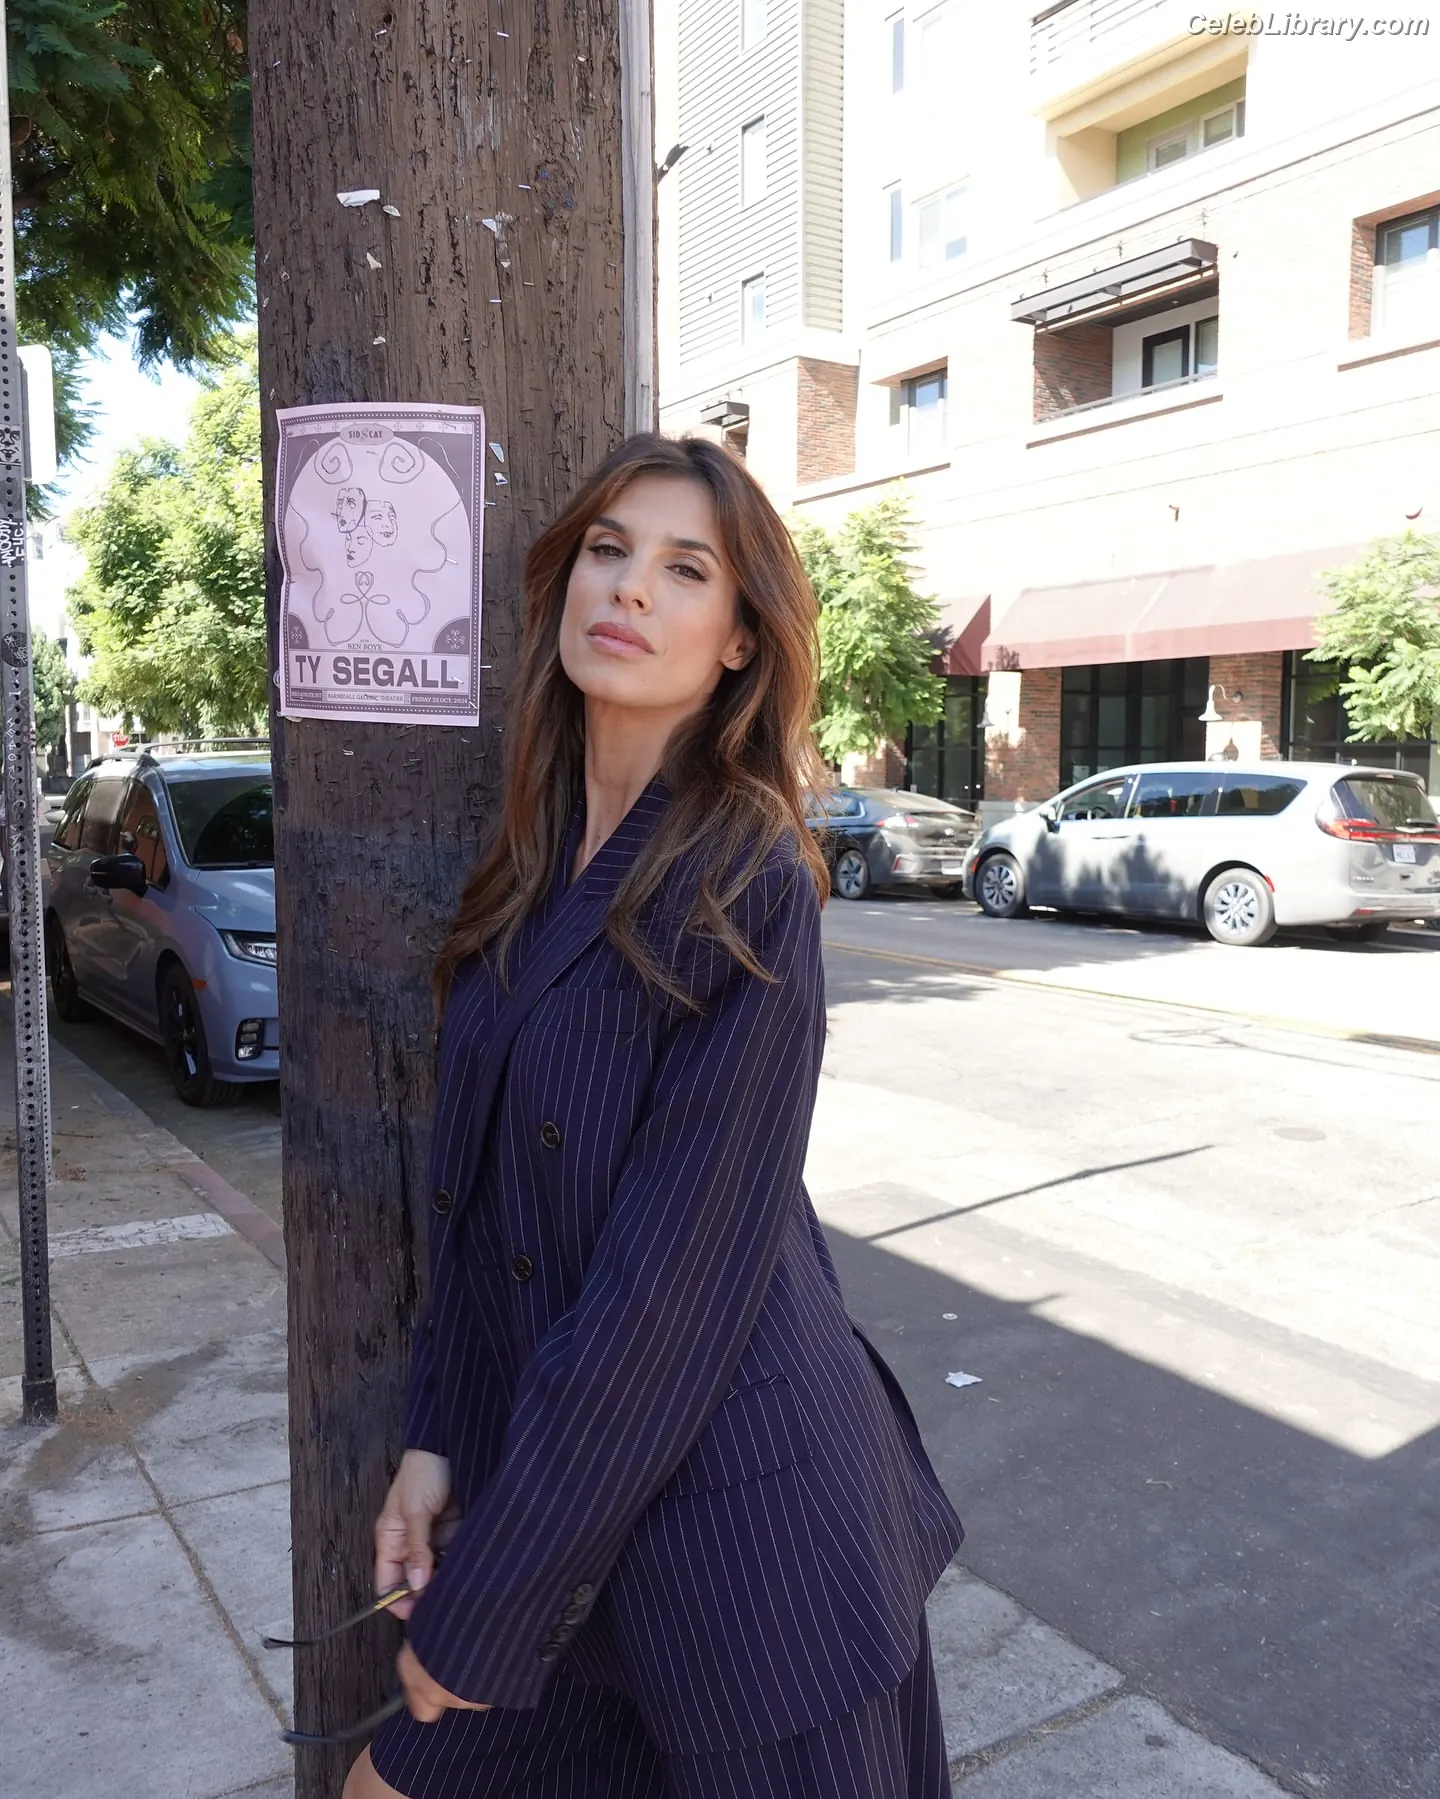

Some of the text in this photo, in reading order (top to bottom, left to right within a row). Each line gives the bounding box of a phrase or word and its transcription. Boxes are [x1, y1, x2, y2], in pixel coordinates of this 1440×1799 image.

[368, 430, 382, 439] CAT
[295, 656, 459, 689] TY SEGALL
